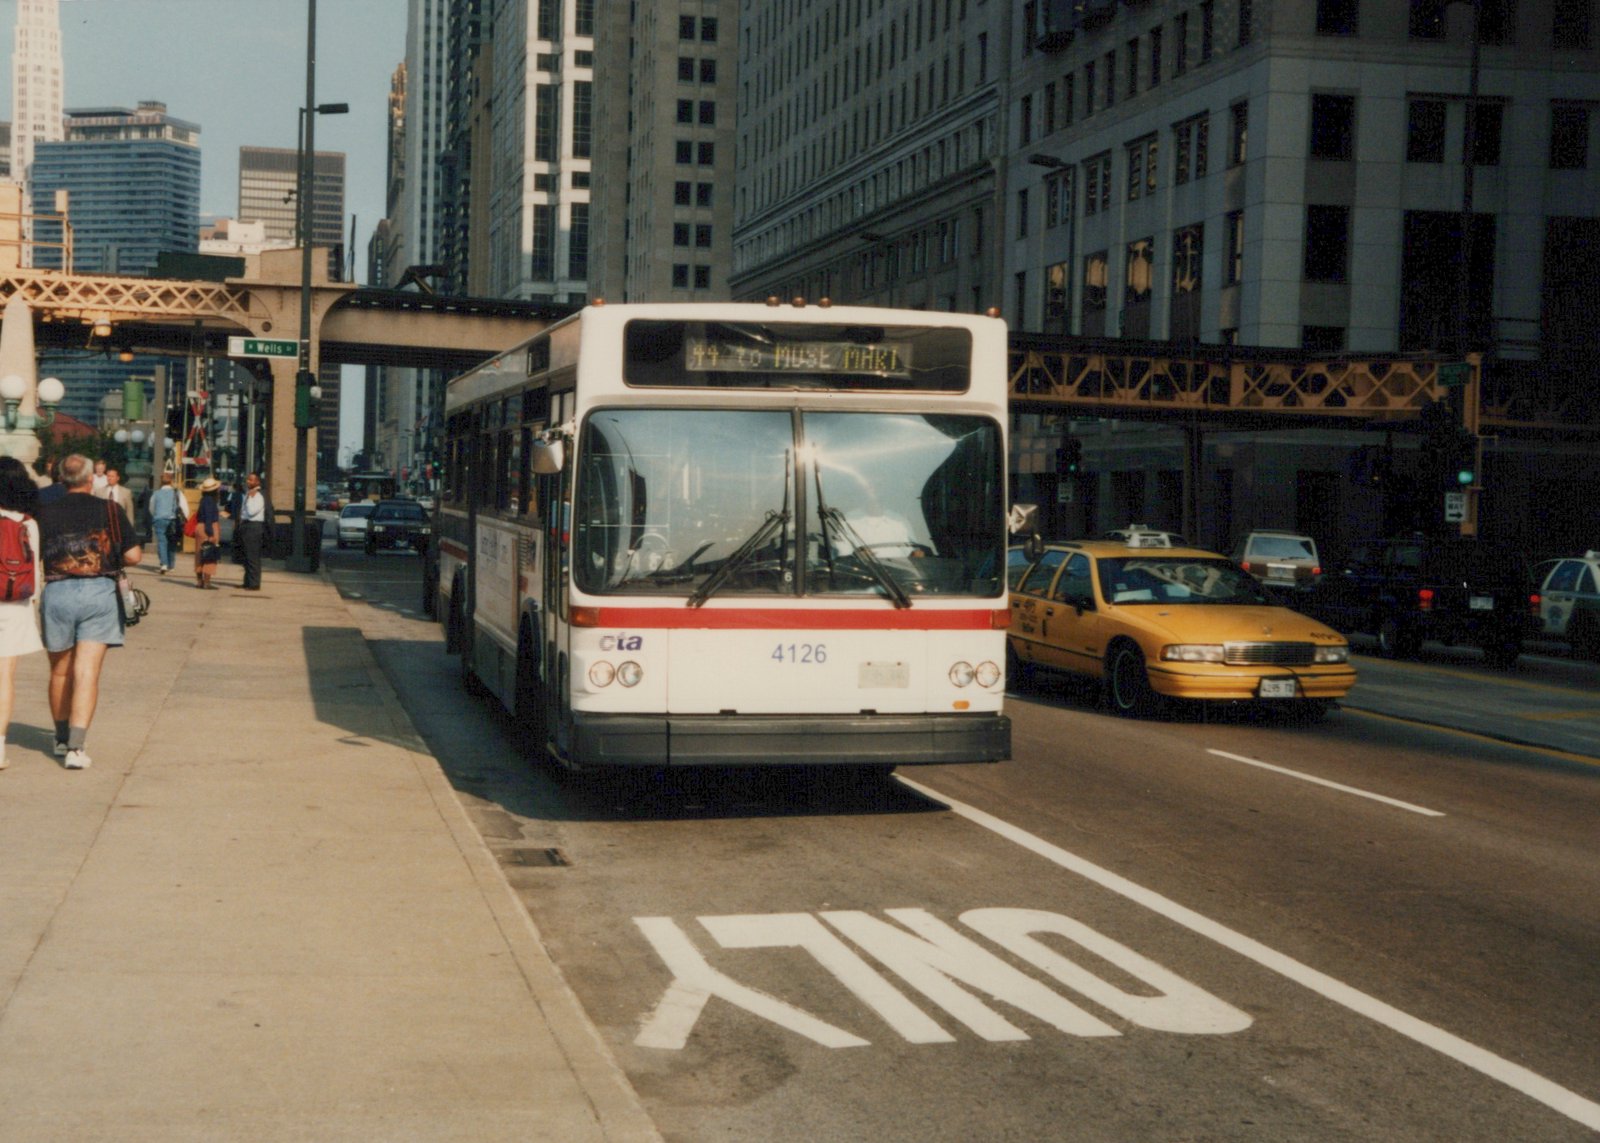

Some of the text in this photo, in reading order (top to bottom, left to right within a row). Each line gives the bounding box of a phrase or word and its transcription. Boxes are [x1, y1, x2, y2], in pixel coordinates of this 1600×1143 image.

[257, 342, 282, 354] Wells
[1447, 494, 1463, 502] ONE
[784, 571, 793, 582] 6
[599, 632, 643, 651] cta
[771, 643, 827, 663] 4126
[632, 907, 1253, 1050] ONLY
